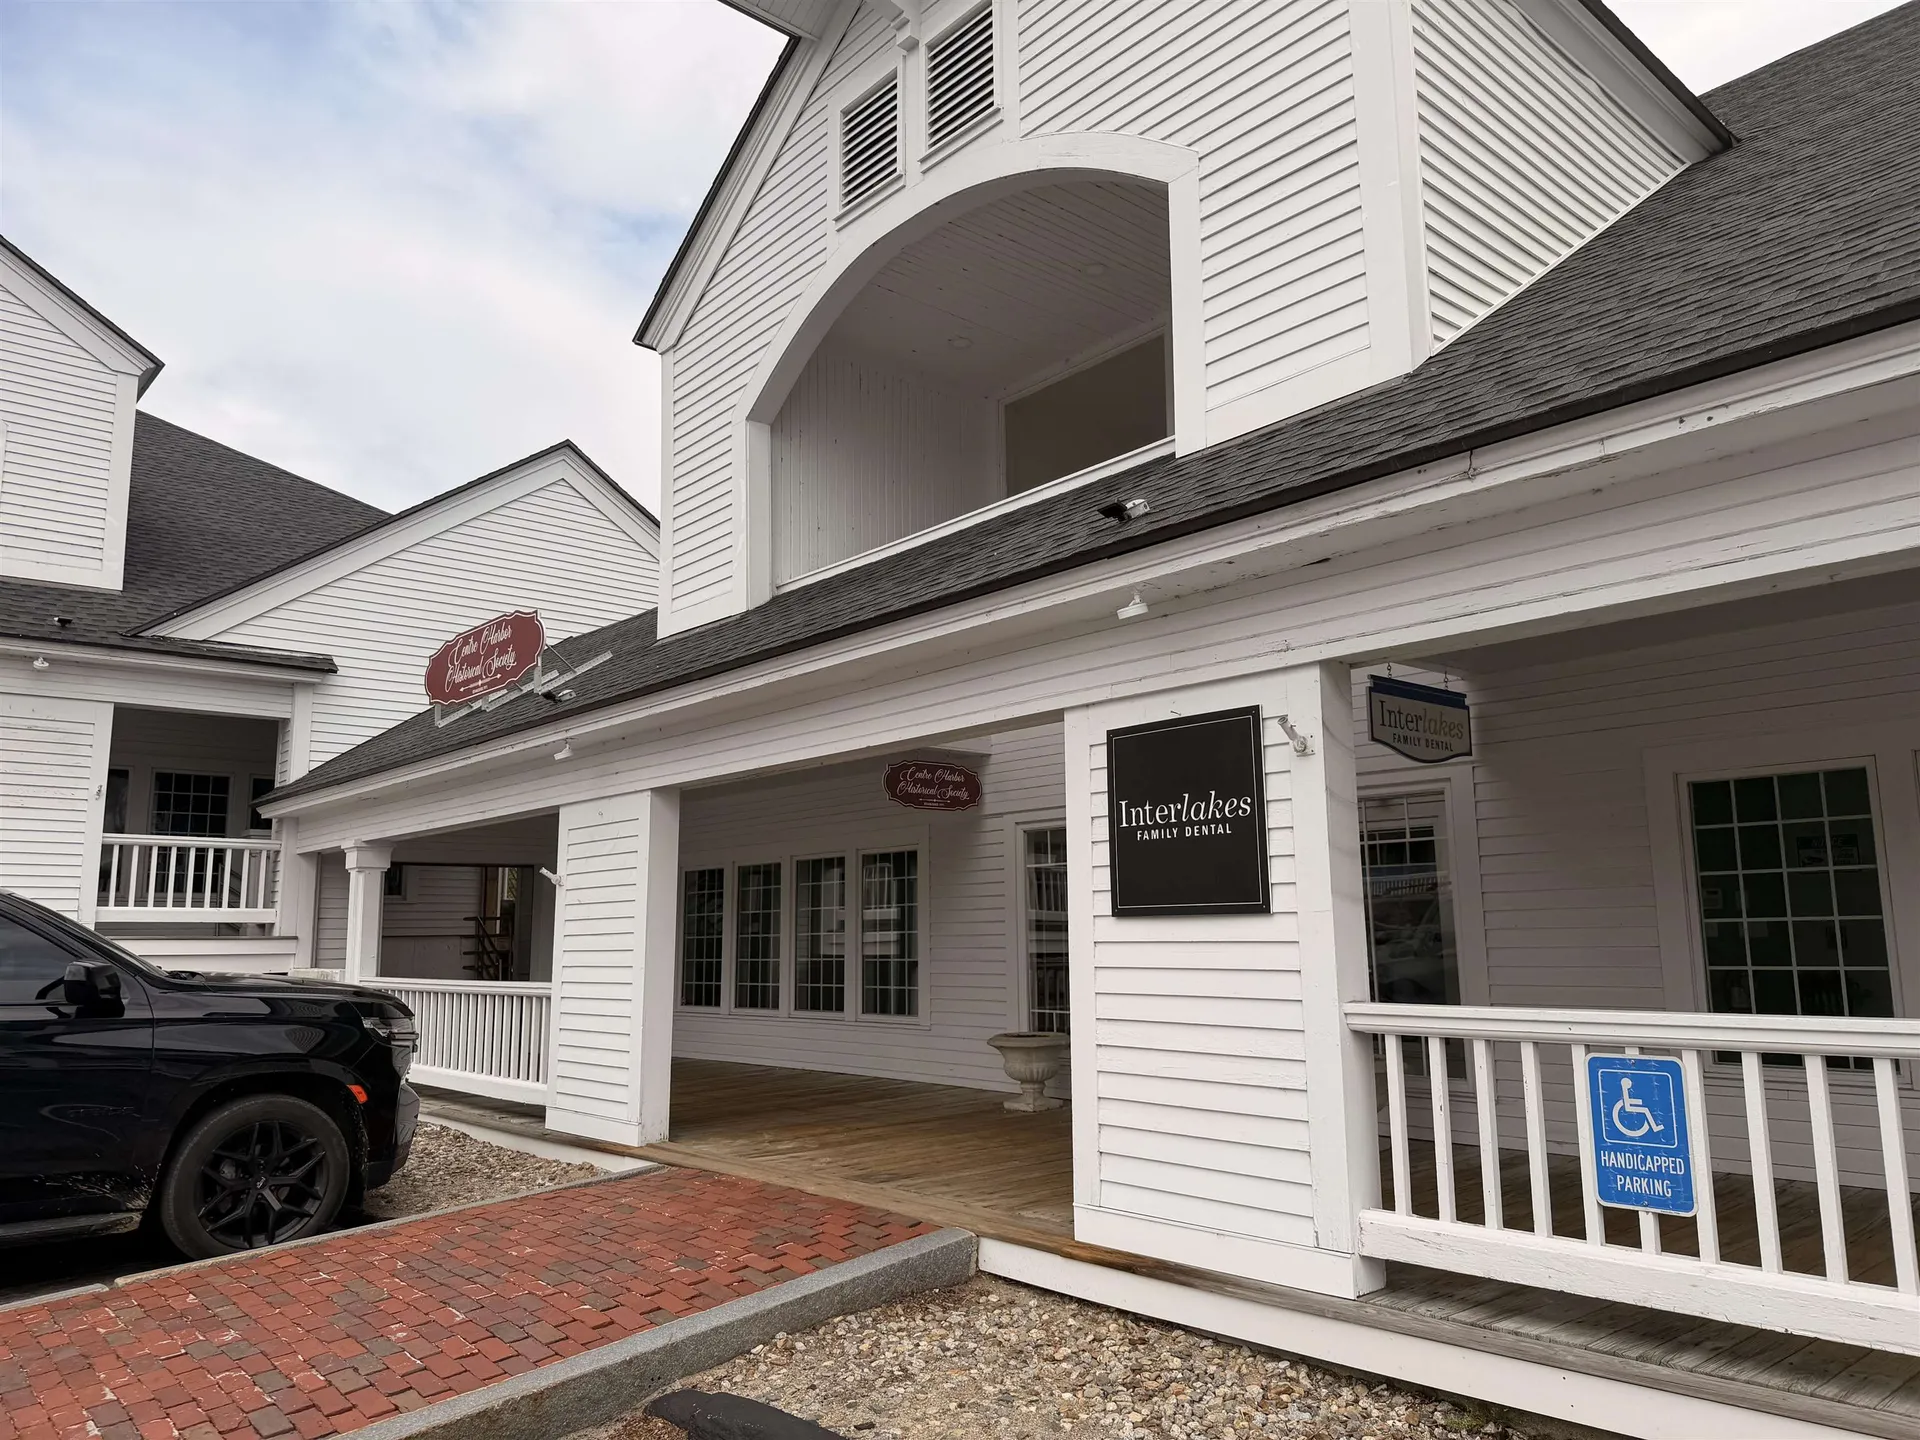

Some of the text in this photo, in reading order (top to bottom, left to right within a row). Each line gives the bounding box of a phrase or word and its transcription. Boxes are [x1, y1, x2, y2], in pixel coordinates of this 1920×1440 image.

[448, 622, 512, 667] Centre Harbor
[445, 644, 517, 692] Historical Society
[1379, 700, 1464, 740] Interlakes
[1392, 733, 1454, 752] FAMILY DENTAL
[900, 766, 966, 783] Centre Harbor
[897, 781, 970, 801] Historical Society
[1119, 790, 1252, 828] Interlakes
[1137, 823, 1232, 841] FAMILY DENTAL
[1600, 1150, 1685, 1175] HANDICAPPED
[1616, 1174, 1672, 1197] PARKING
